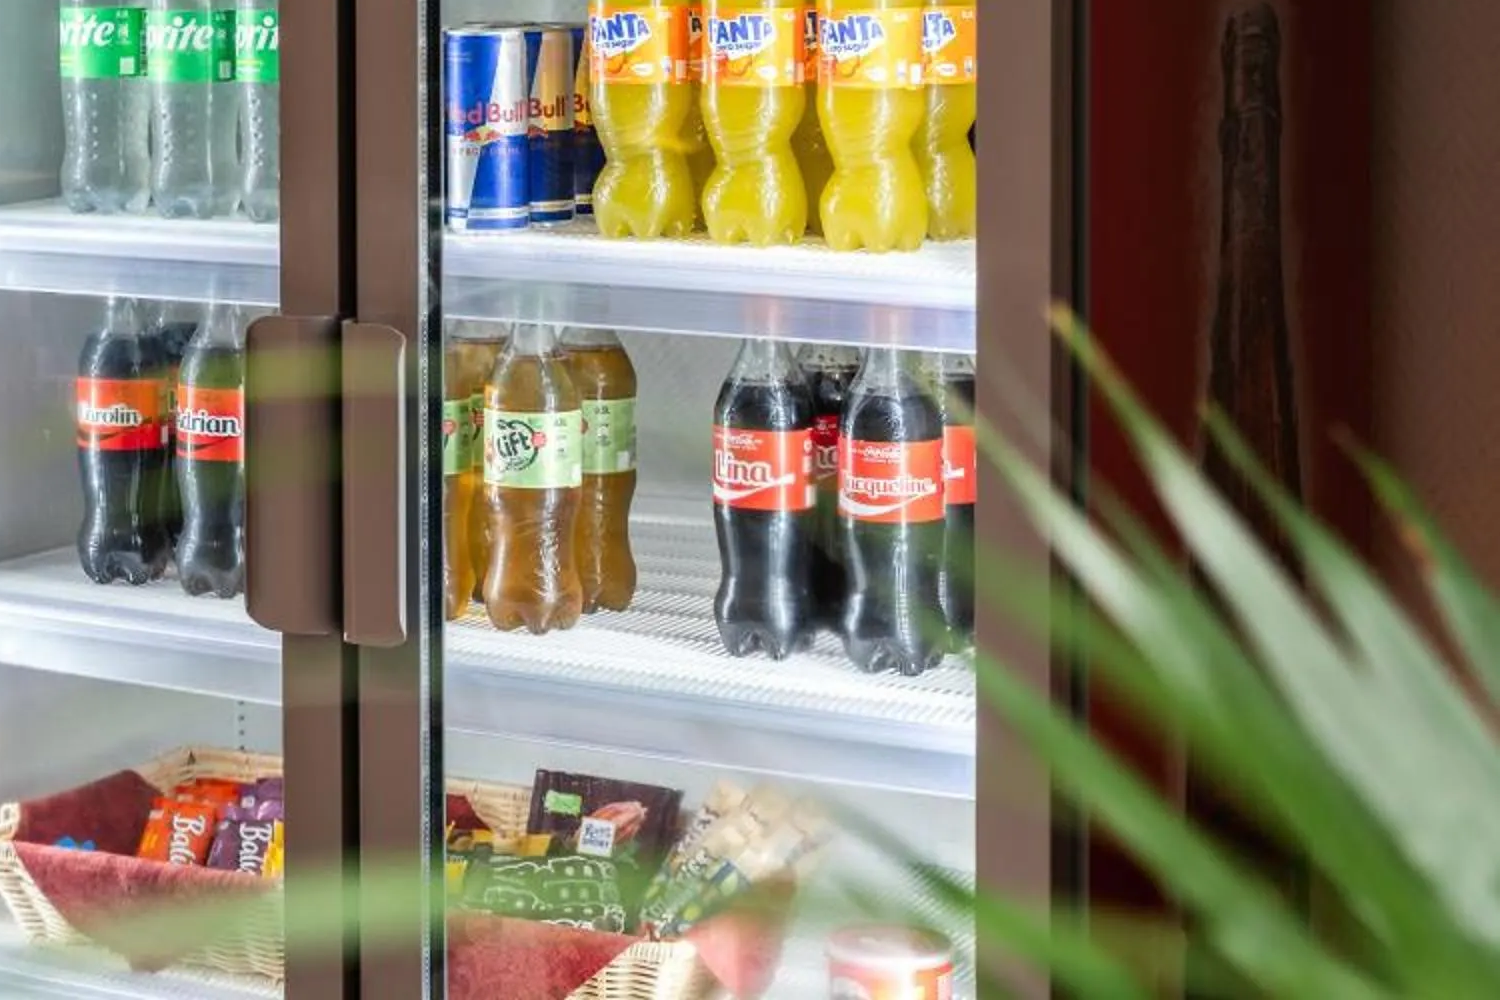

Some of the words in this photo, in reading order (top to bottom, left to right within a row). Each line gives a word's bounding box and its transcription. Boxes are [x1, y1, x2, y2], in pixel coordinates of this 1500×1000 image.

[59, 13, 115, 47] rite
[146, 15, 214, 51] prite
[528, 94, 566, 118] Bull
